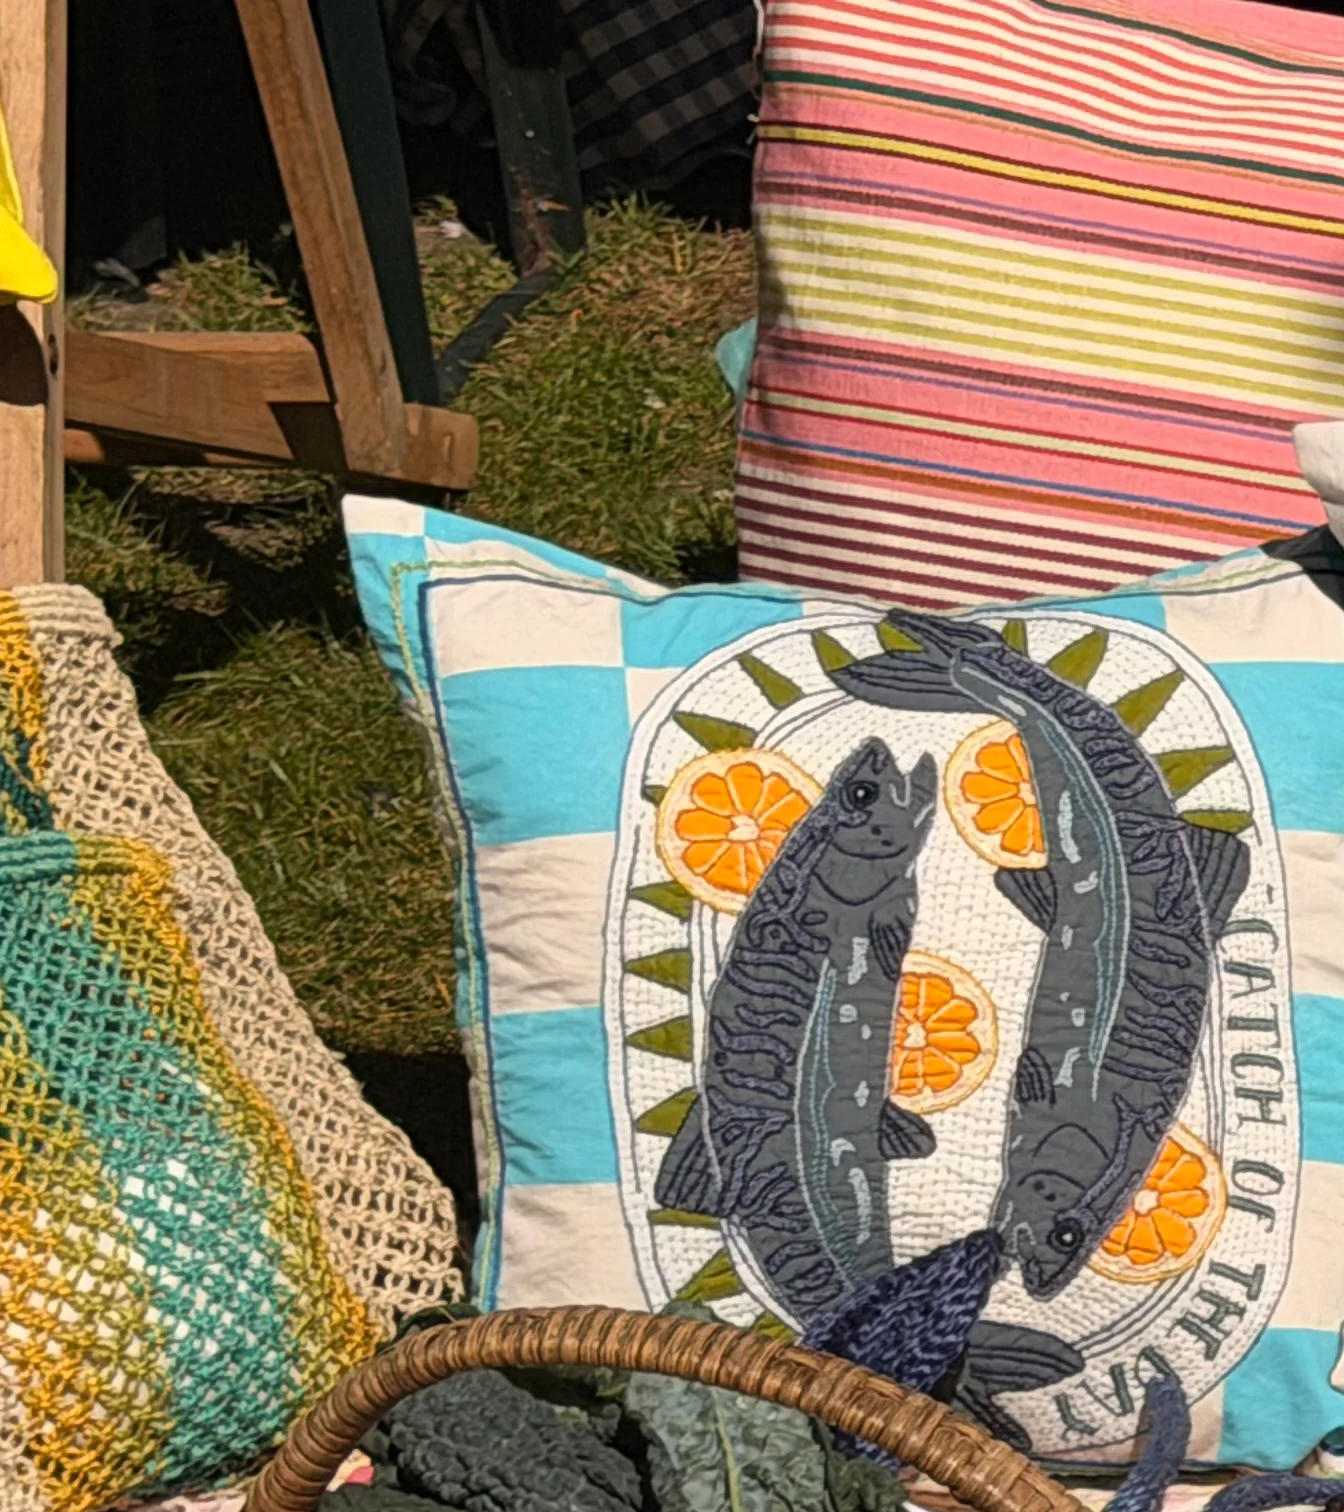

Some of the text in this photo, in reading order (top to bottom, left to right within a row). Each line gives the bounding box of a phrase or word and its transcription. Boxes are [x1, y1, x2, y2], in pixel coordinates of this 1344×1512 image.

[1216, 917, 1288, 1128] CATCH
[1227, 1158, 1286, 1234] OF
[1166, 1260, 1266, 1361] THE
